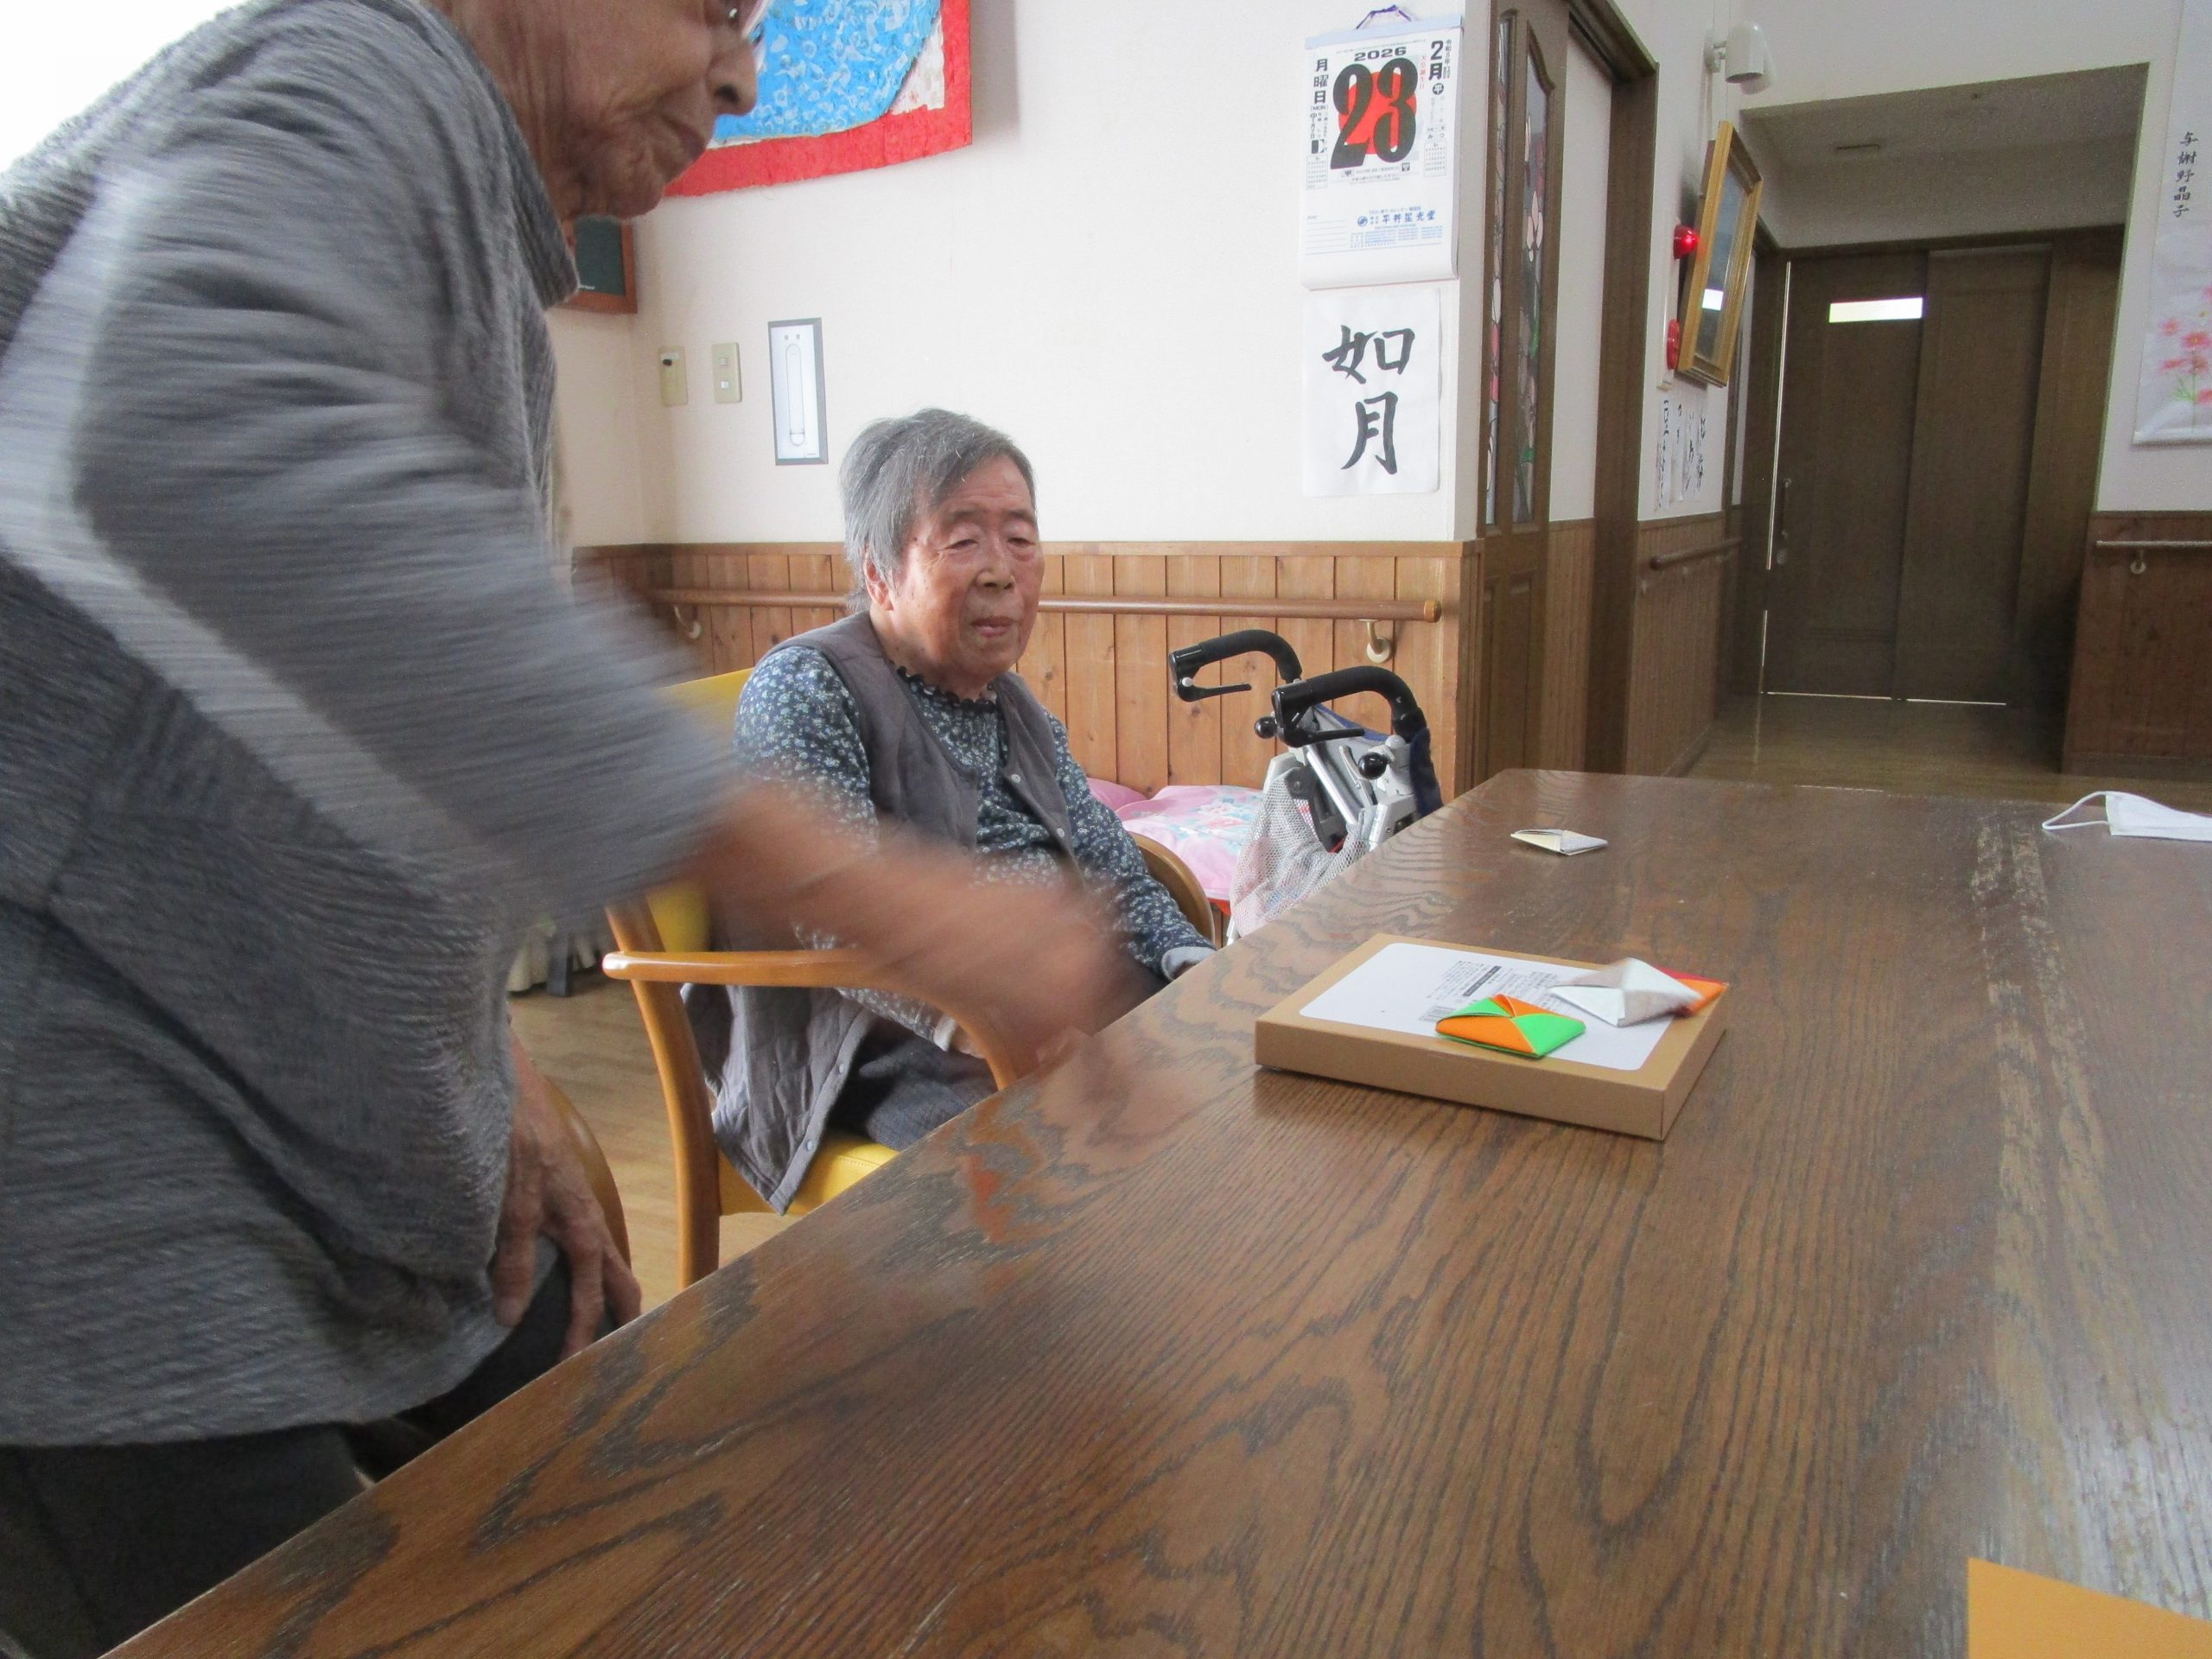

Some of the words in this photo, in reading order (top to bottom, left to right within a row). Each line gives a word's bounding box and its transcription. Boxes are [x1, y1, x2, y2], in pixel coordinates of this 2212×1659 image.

[1354, 47, 1407, 61] 2026
[1428, 40, 1444, 80] 2月
[1313, 58, 1329, 104] 月曜日
[1330, 58, 1418, 169] 23
[1322, 325, 1415, 475] 如月
